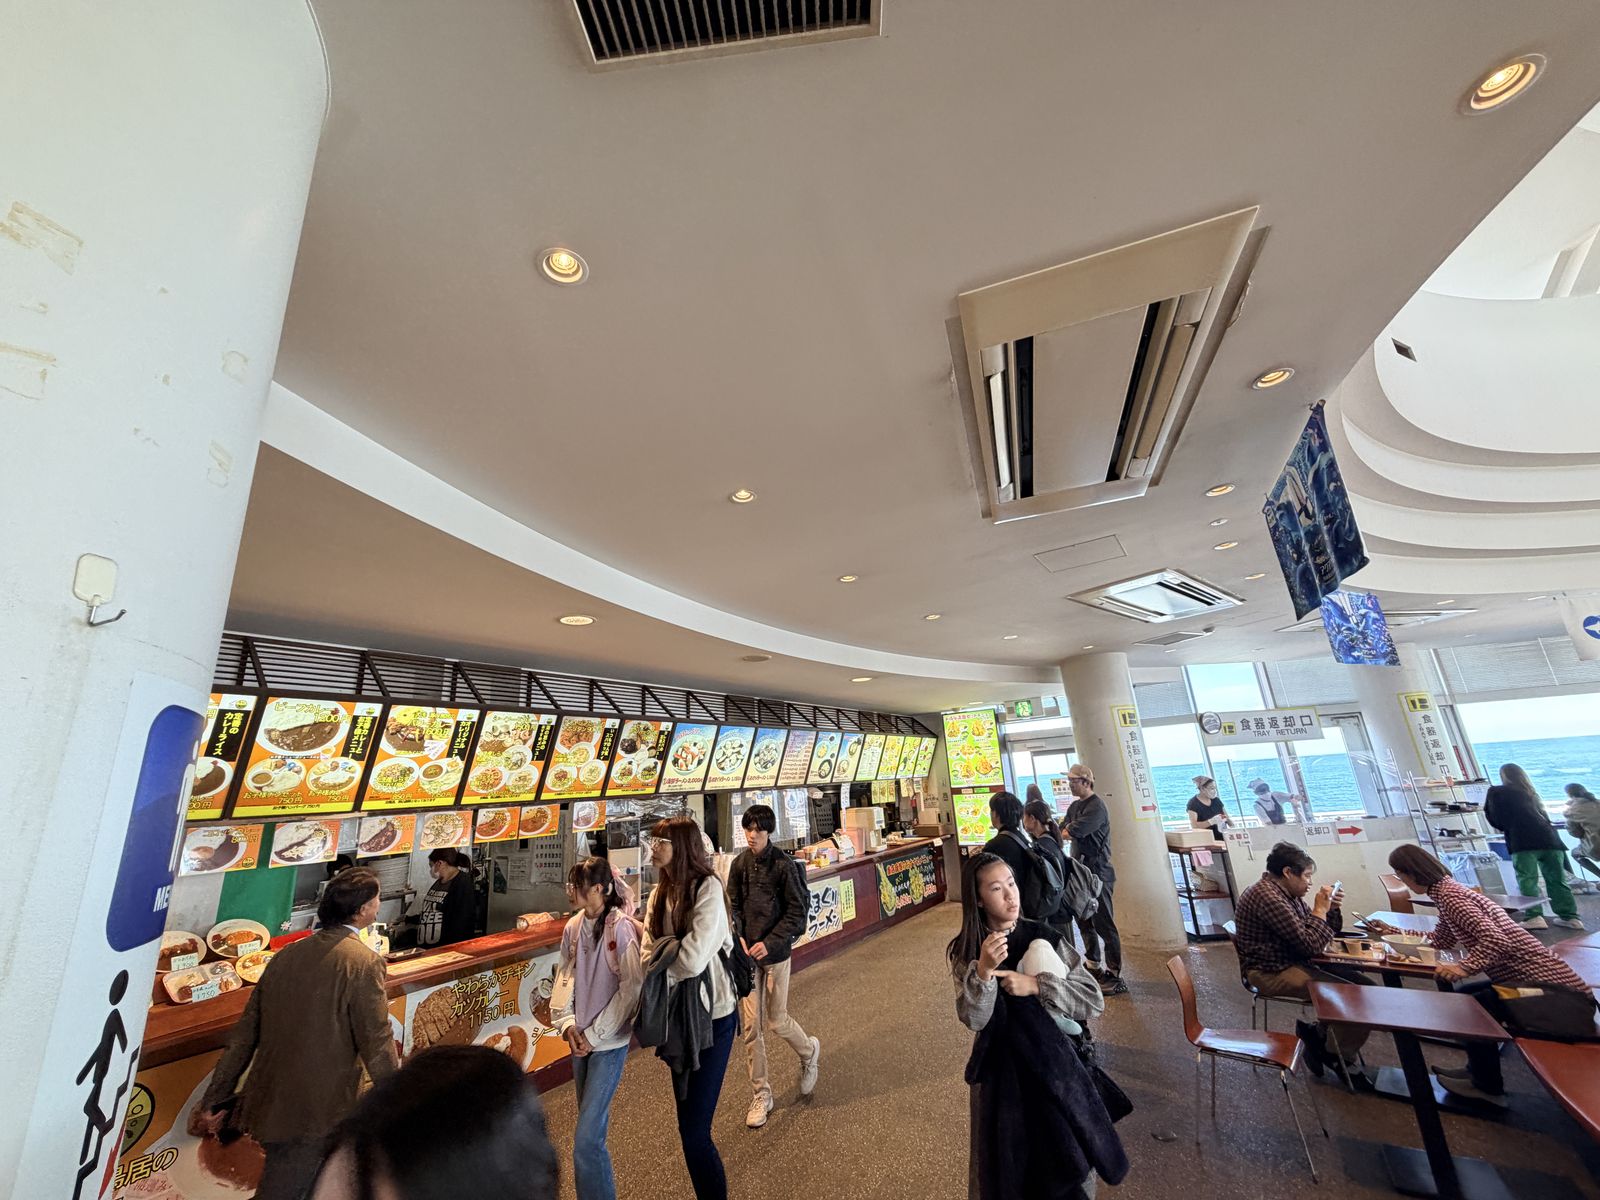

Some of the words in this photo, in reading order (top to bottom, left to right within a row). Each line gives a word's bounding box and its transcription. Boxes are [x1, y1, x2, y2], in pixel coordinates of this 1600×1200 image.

[213, 712, 234, 756] カレーライス
[229, 712, 244, 735] 定番の
[1240, 715, 1313, 731] 食器返却口
[1276, 727, 1308, 736] RETURN
[1129, 730, 1150, 798] 食器返却口
[1229, 833, 1249, 841] 返却口
[1306, 826, 1330, 836] 返却口
[421, 912, 443, 924] SEE
[452, 963, 536, 999] やわらかチキン
[450, 990, 510, 1019] カツカレー
[469, 1001, 516, 1029] 1150円
